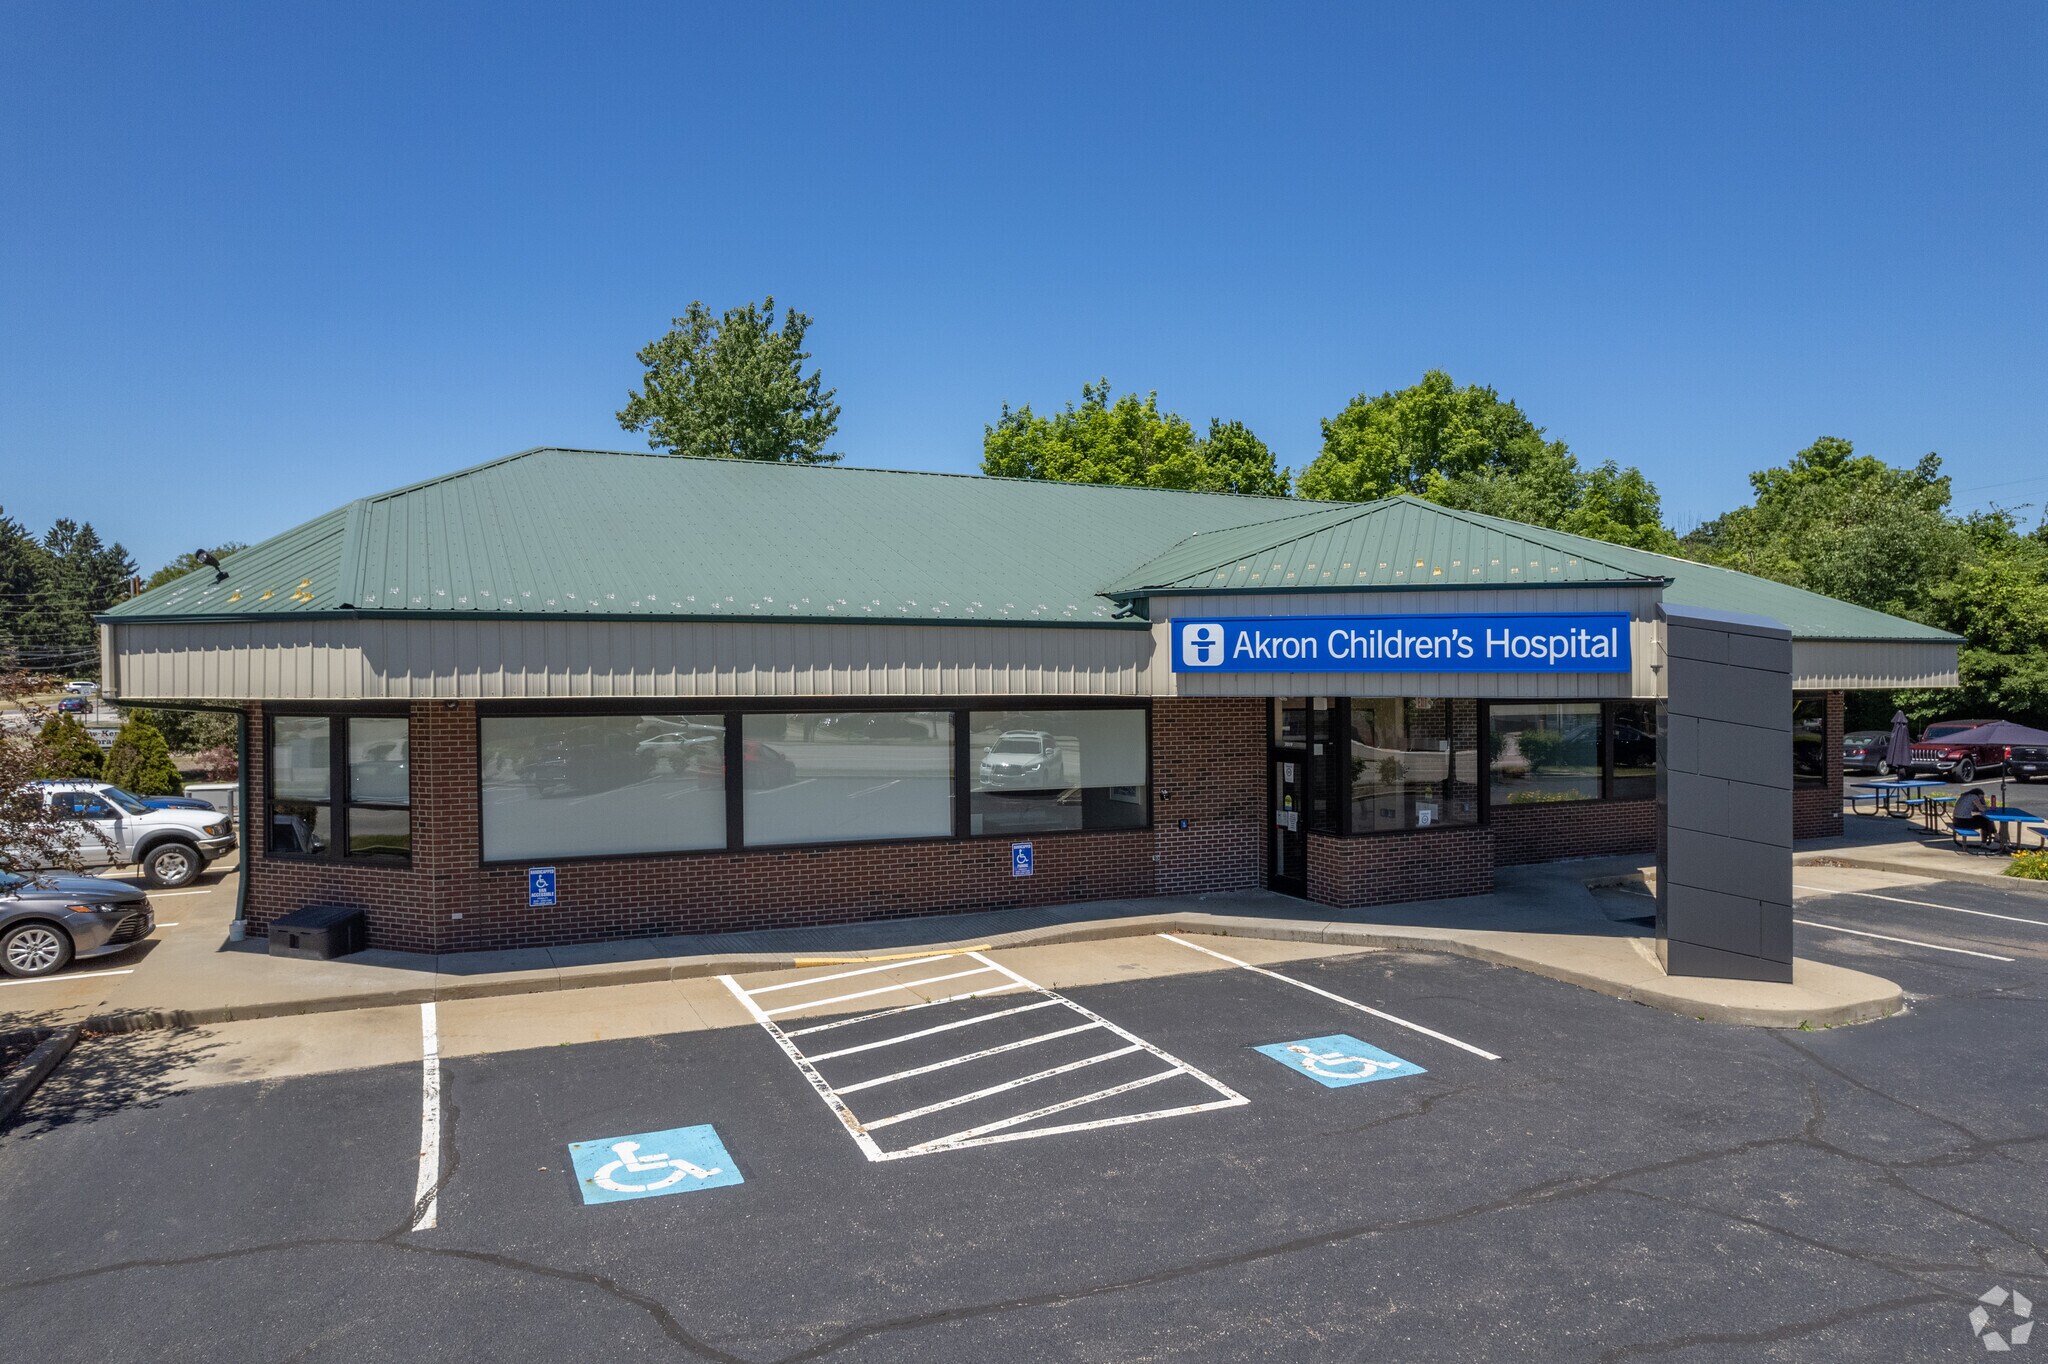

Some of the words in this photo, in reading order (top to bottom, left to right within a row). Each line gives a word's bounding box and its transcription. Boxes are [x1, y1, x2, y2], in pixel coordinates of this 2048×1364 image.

[1233, 630, 1317, 659] Akron
[1328, 629, 1474, 659] Children's
[1486, 627, 1618, 665] Hospital
